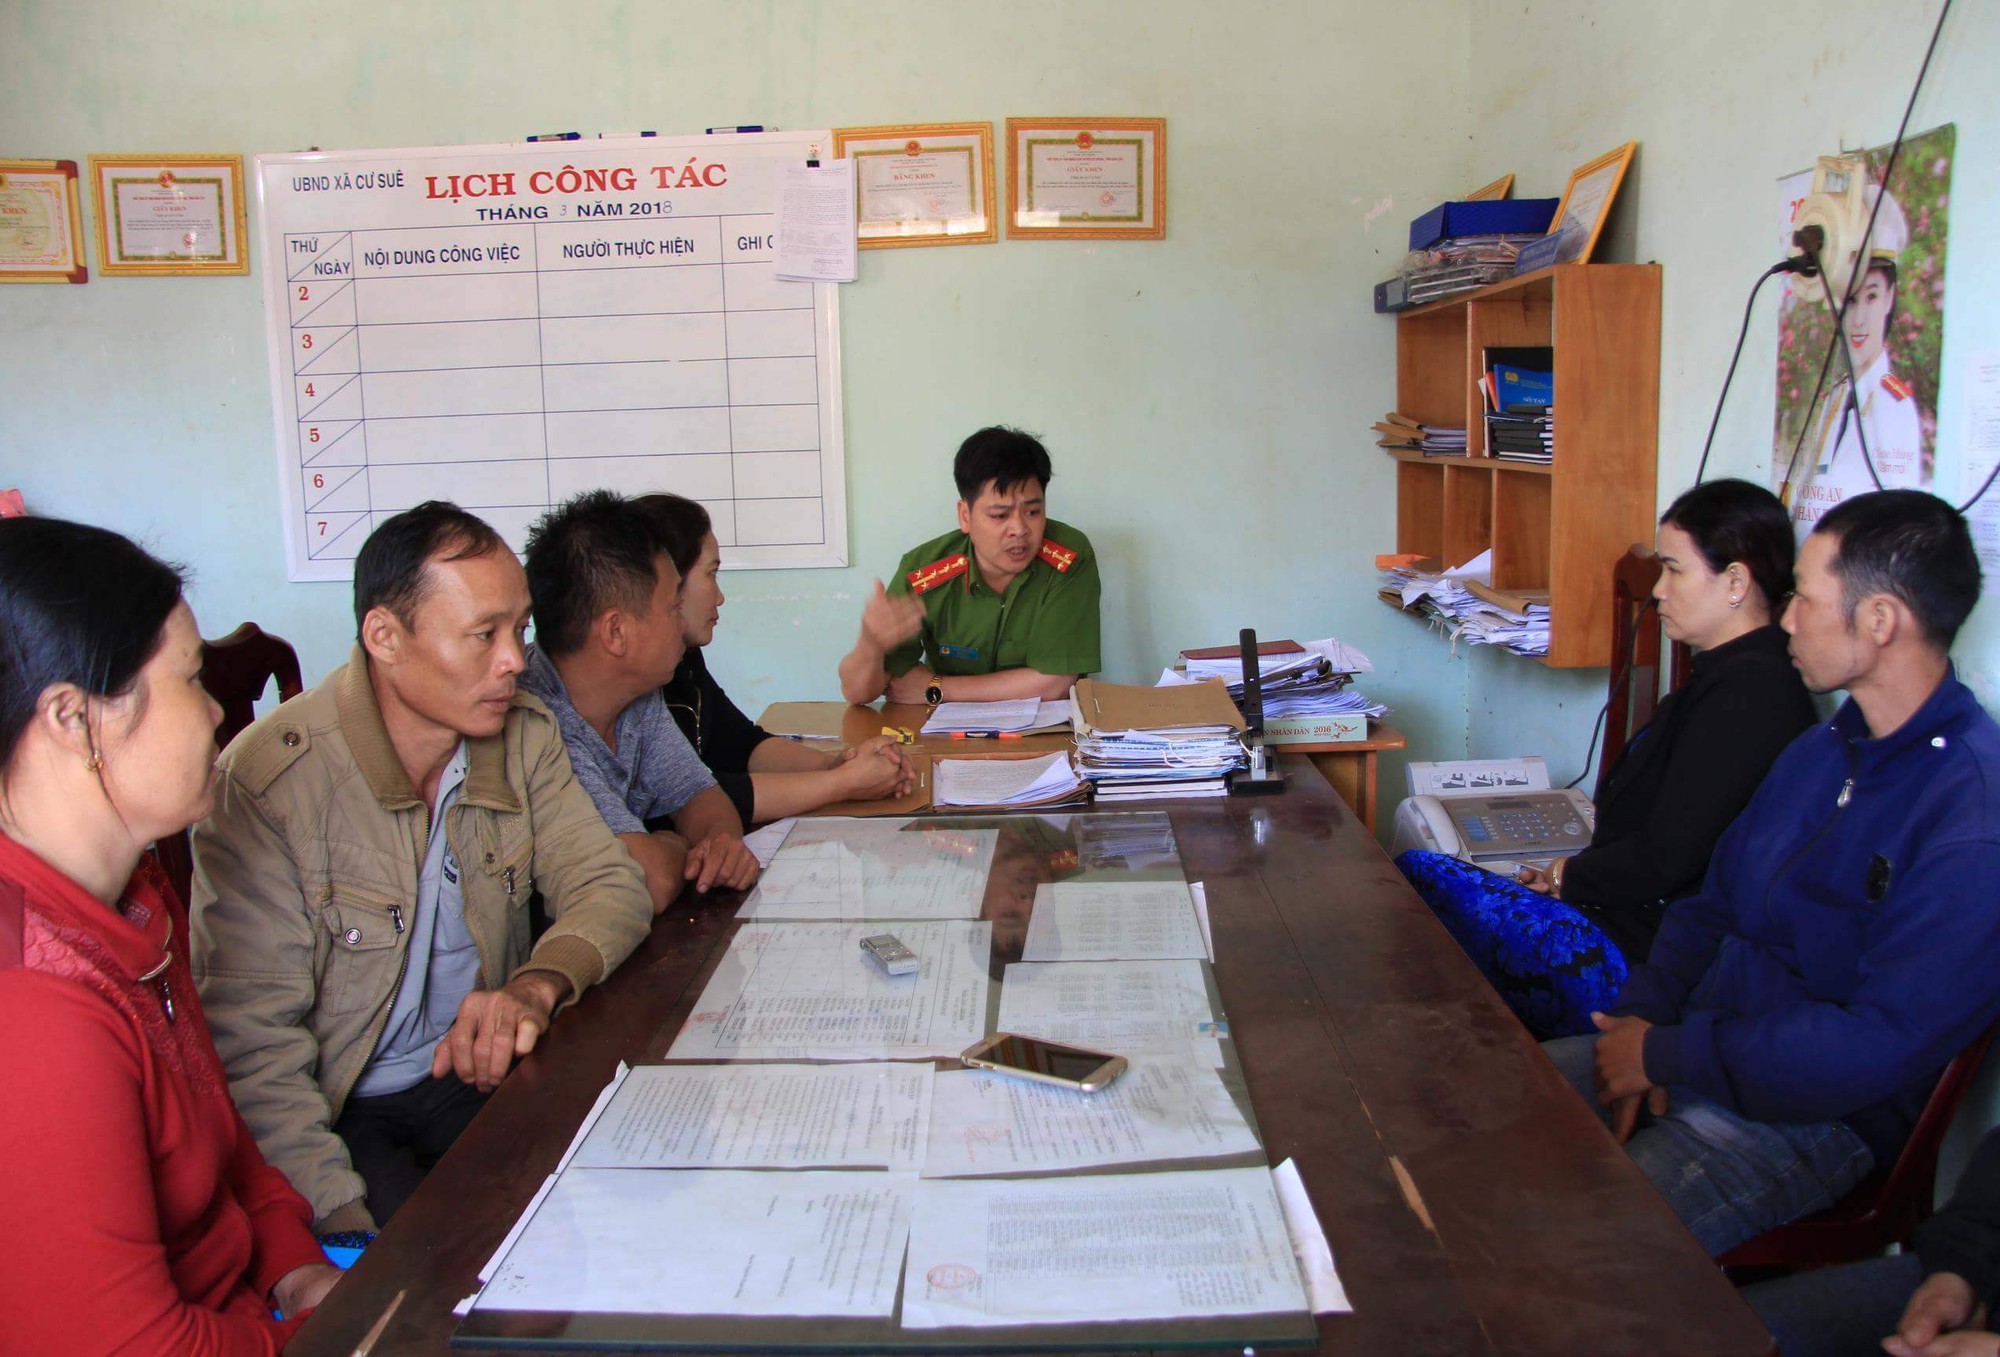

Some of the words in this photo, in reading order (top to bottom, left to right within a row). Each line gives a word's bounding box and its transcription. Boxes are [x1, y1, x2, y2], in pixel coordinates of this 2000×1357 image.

[293, 176, 330, 192] UBND
[334, 172, 352, 190] XÃ
[378, 169, 404, 188] SUÊ
[425, 172, 516, 204] LỊCH
[528, 164, 637, 195] CÔNG
[650, 157, 728, 189] TÁC
[475, 204, 549, 222] THÁNG
[560, 204, 568, 217] 3
[576, 201, 623, 218] NĂM
[629, 201, 673, 215] 2018
[291, 237, 319, 254] THỨ
[563, 238, 611, 259] NGƯỜI
[615, 240, 656, 259] THỰC
[659, 237, 695, 257] HIỆN
[737, 236, 762, 251] GHI
[364, 248, 390, 270] NỘI
[393, 249, 436, 265] DUNG
[439, 243, 483, 263] CÔNG
[488, 243, 521, 264] VIỆC
[314, 258, 351, 275] NGÀY
[298, 286, 309, 301] 2
[302, 334, 313, 349] 3
[305, 383, 315, 397] 4
[309, 428, 320, 443] 5
[313, 474, 324, 488] 6
[1826, 486, 1842, 502] AN
[317, 522, 328, 536] 7
